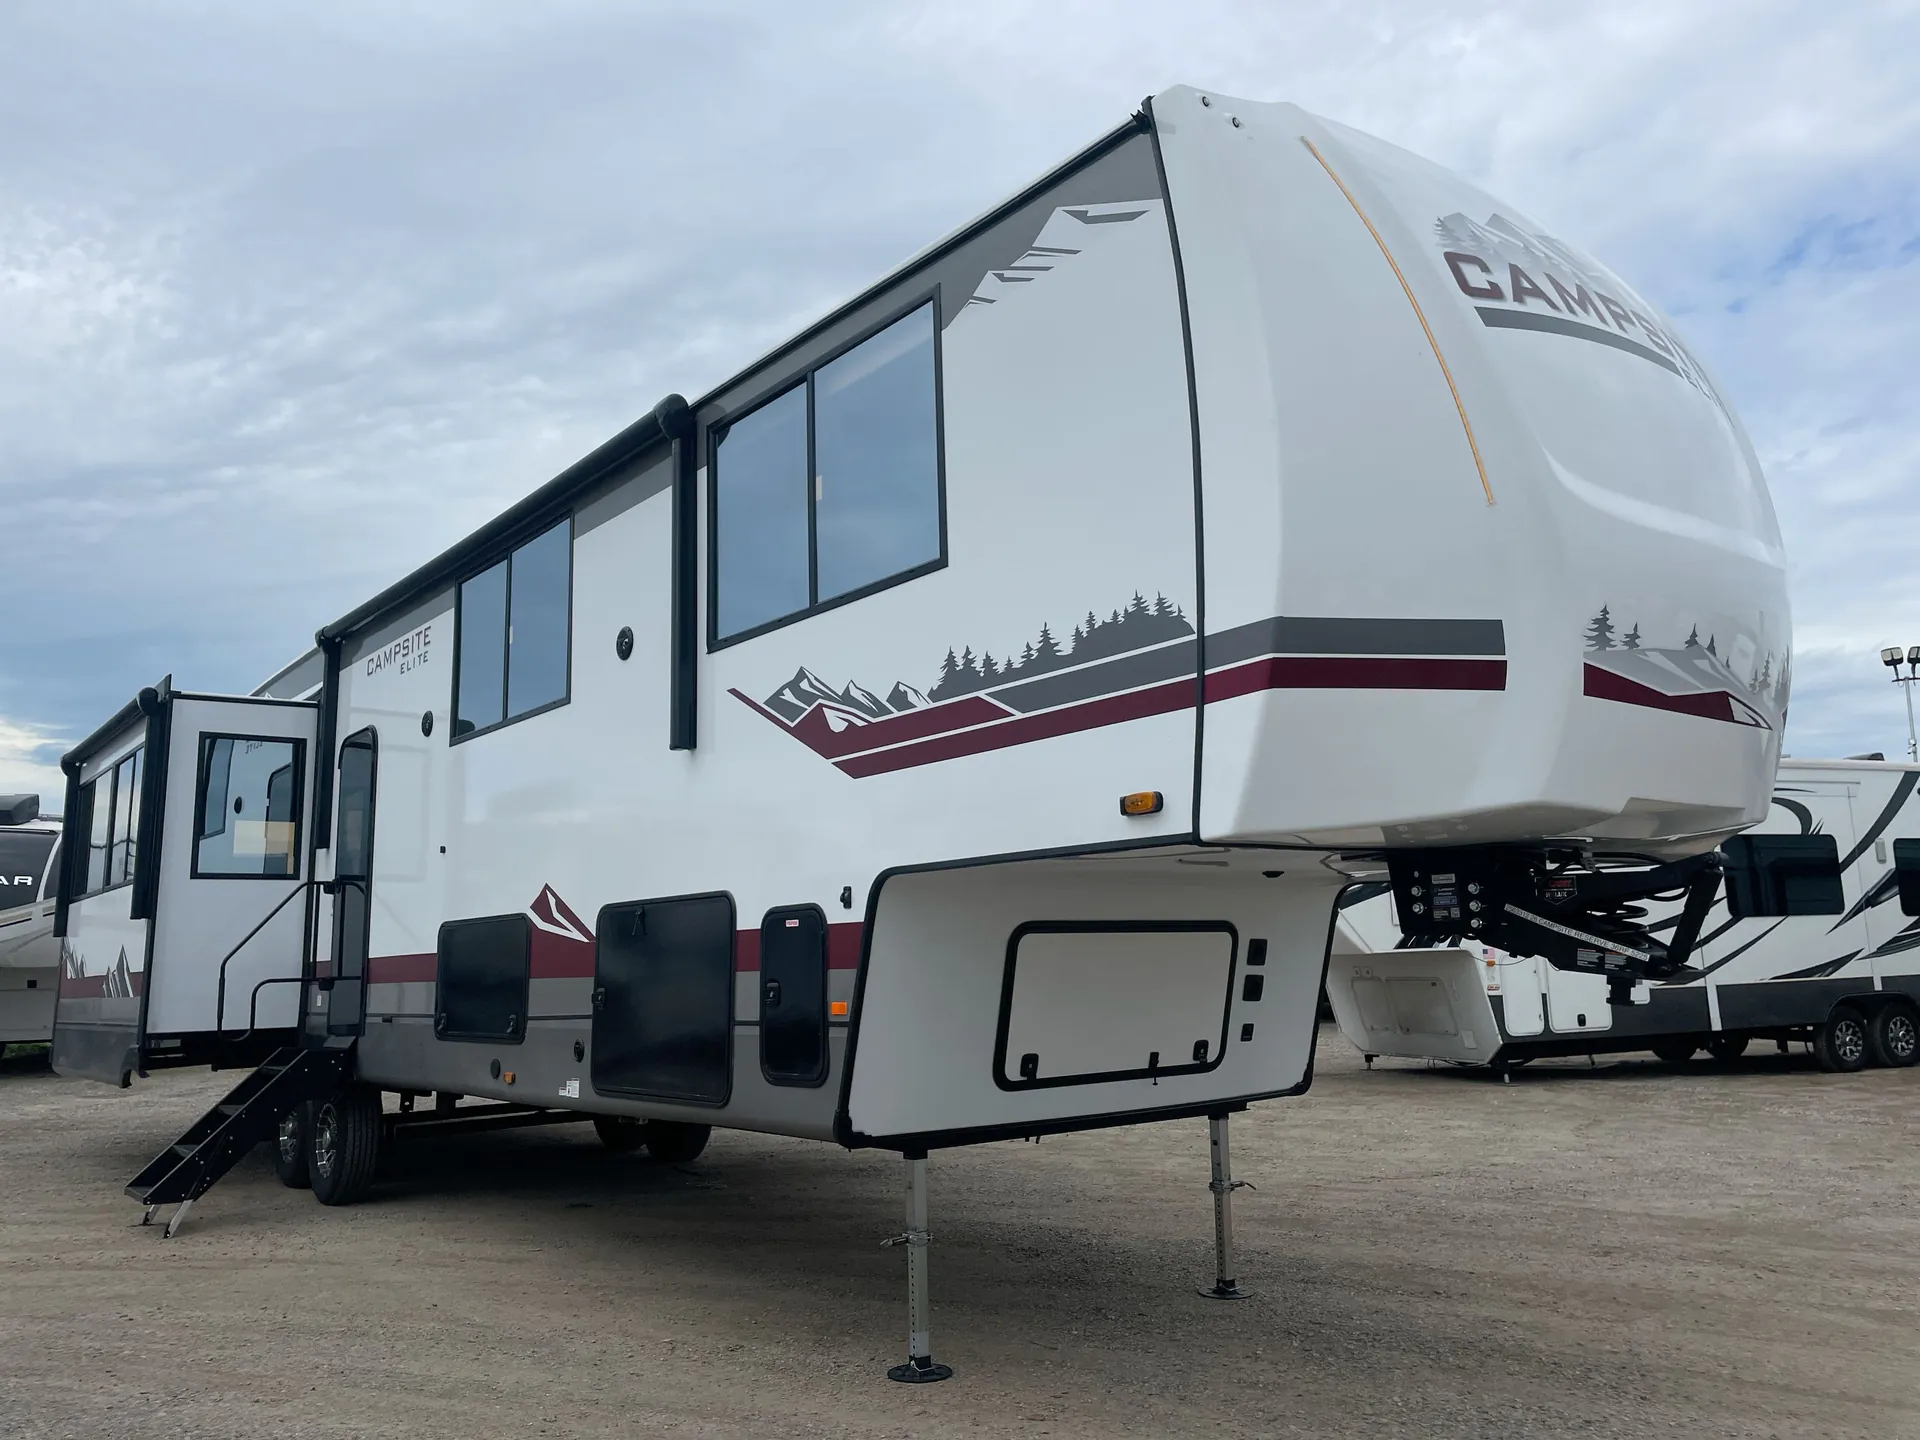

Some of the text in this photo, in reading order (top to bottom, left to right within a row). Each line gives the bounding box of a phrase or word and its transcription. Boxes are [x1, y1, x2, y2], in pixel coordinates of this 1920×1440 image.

[366, 626, 432, 676] CAMPSITE
[400, 651, 429, 675] ELITE
[1538, 918, 1573, 935] CAMPSITE
[1575, 931, 1610, 947] RESERVE
